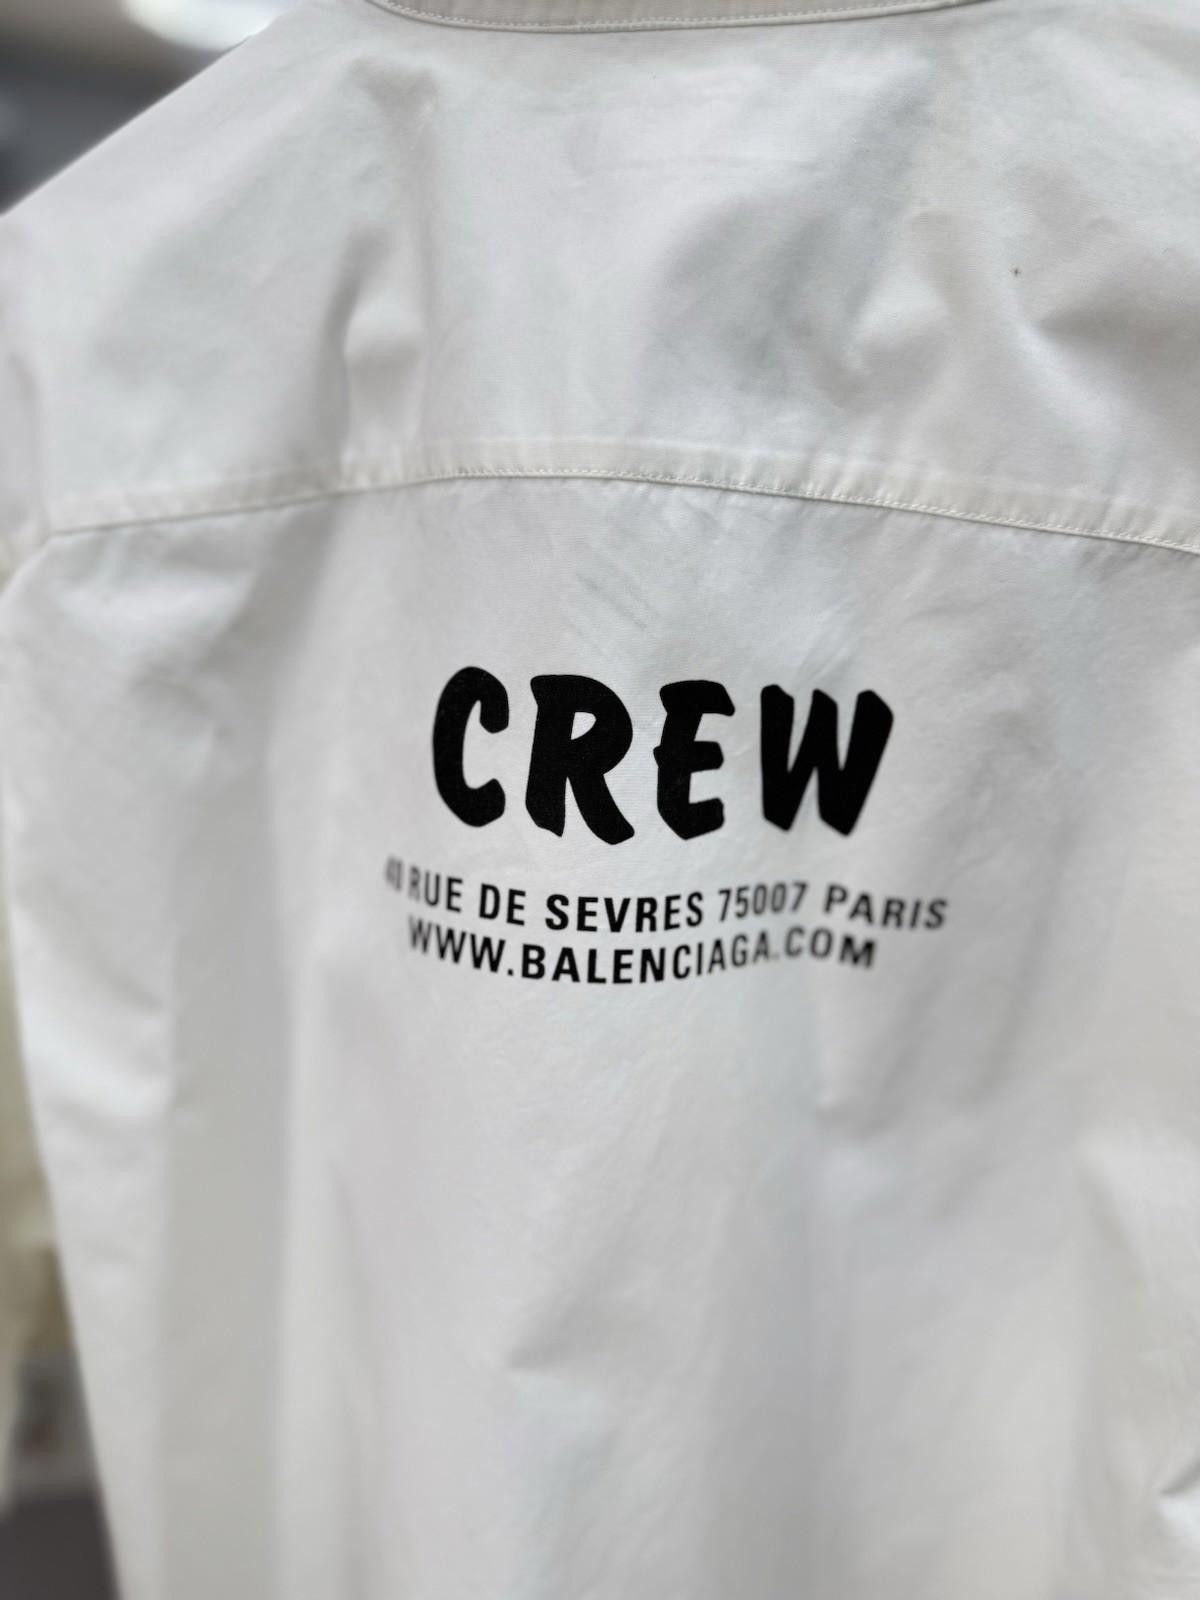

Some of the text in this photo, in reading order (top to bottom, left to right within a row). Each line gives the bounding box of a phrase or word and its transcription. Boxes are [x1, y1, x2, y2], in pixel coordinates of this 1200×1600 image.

[431, 665, 895, 846] CREW
[408, 864, 463, 913] RUE
[478, 883, 527, 927] DE
[544, 892, 704, 934] SEVRES
[717, 882, 809, 923] 75007
[823, 883, 949, 931] PARIS
[407, 914, 877, 985] WWW.BALENCIAGA.COM
